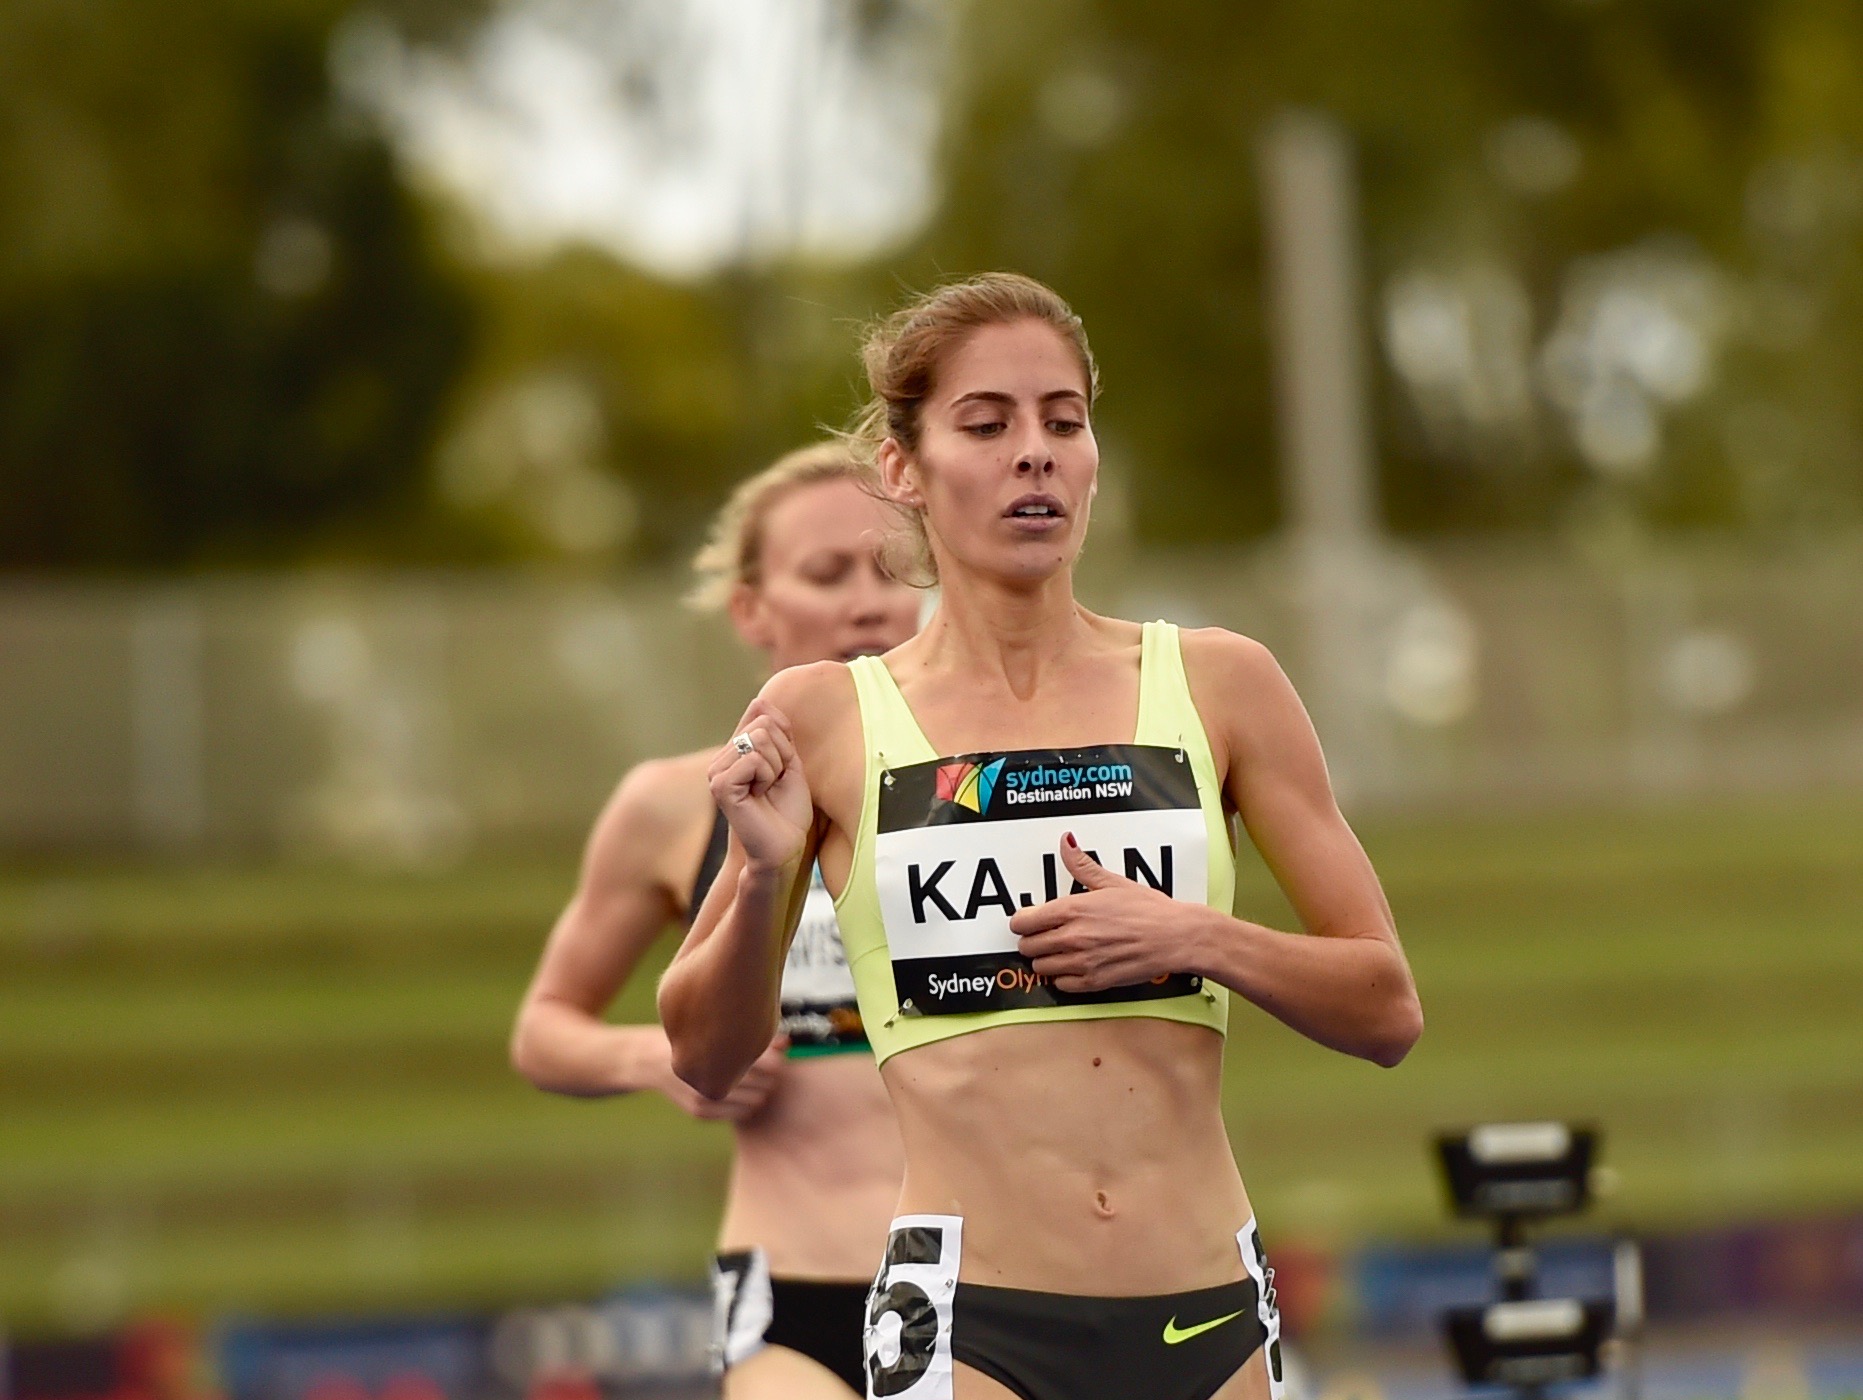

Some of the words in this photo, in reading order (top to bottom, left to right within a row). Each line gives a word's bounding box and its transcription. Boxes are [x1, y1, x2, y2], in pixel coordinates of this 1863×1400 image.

[1006, 765, 1133, 791] sydney.com
[1006, 785, 1092, 805] Destination
[1095, 781, 1133, 799] NSW
[907, 844, 1174, 924] KAJN
[715, 1252, 753, 1335] 7
[868, 1226, 944, 1398] 5
